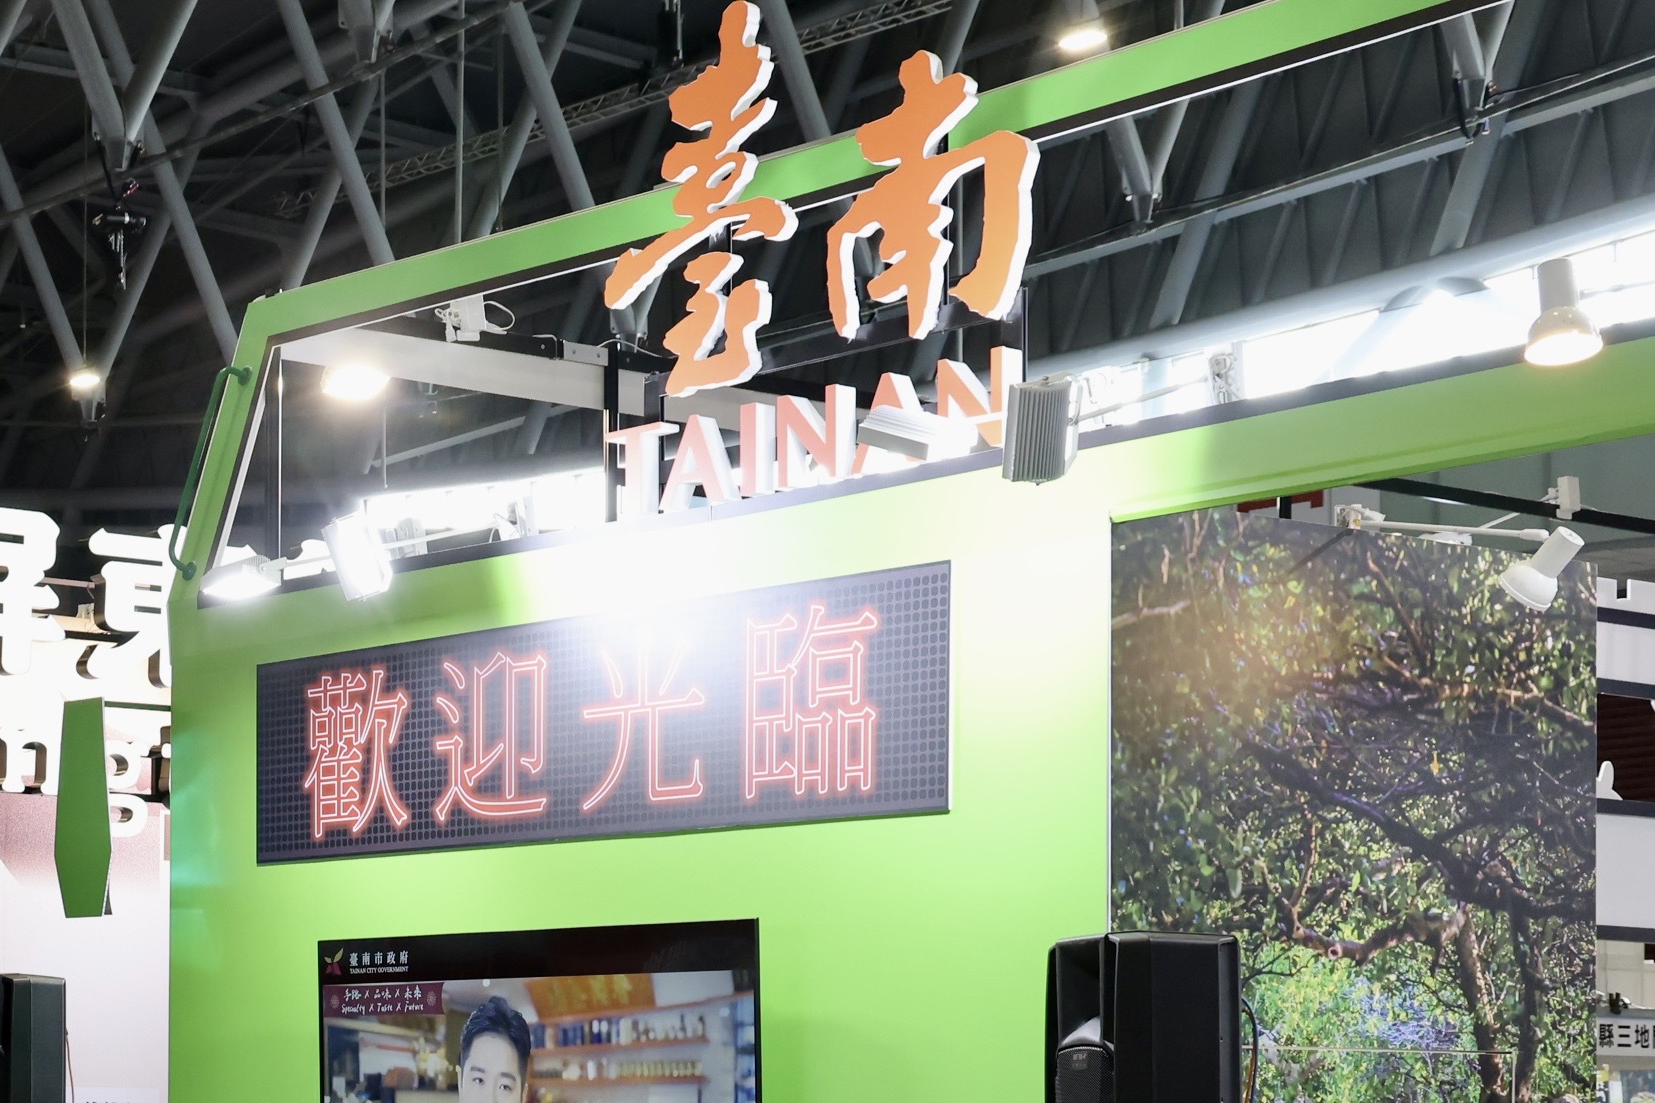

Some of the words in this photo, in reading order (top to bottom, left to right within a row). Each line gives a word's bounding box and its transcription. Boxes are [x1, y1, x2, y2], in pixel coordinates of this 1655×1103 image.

[605, 0, 1041, 397] 臺南
[303, 603, 880, 841] 歡迎光臨
[349, 950, 409, 967] 臺南市政府
[349, 967, 366, 975] TAINAN
